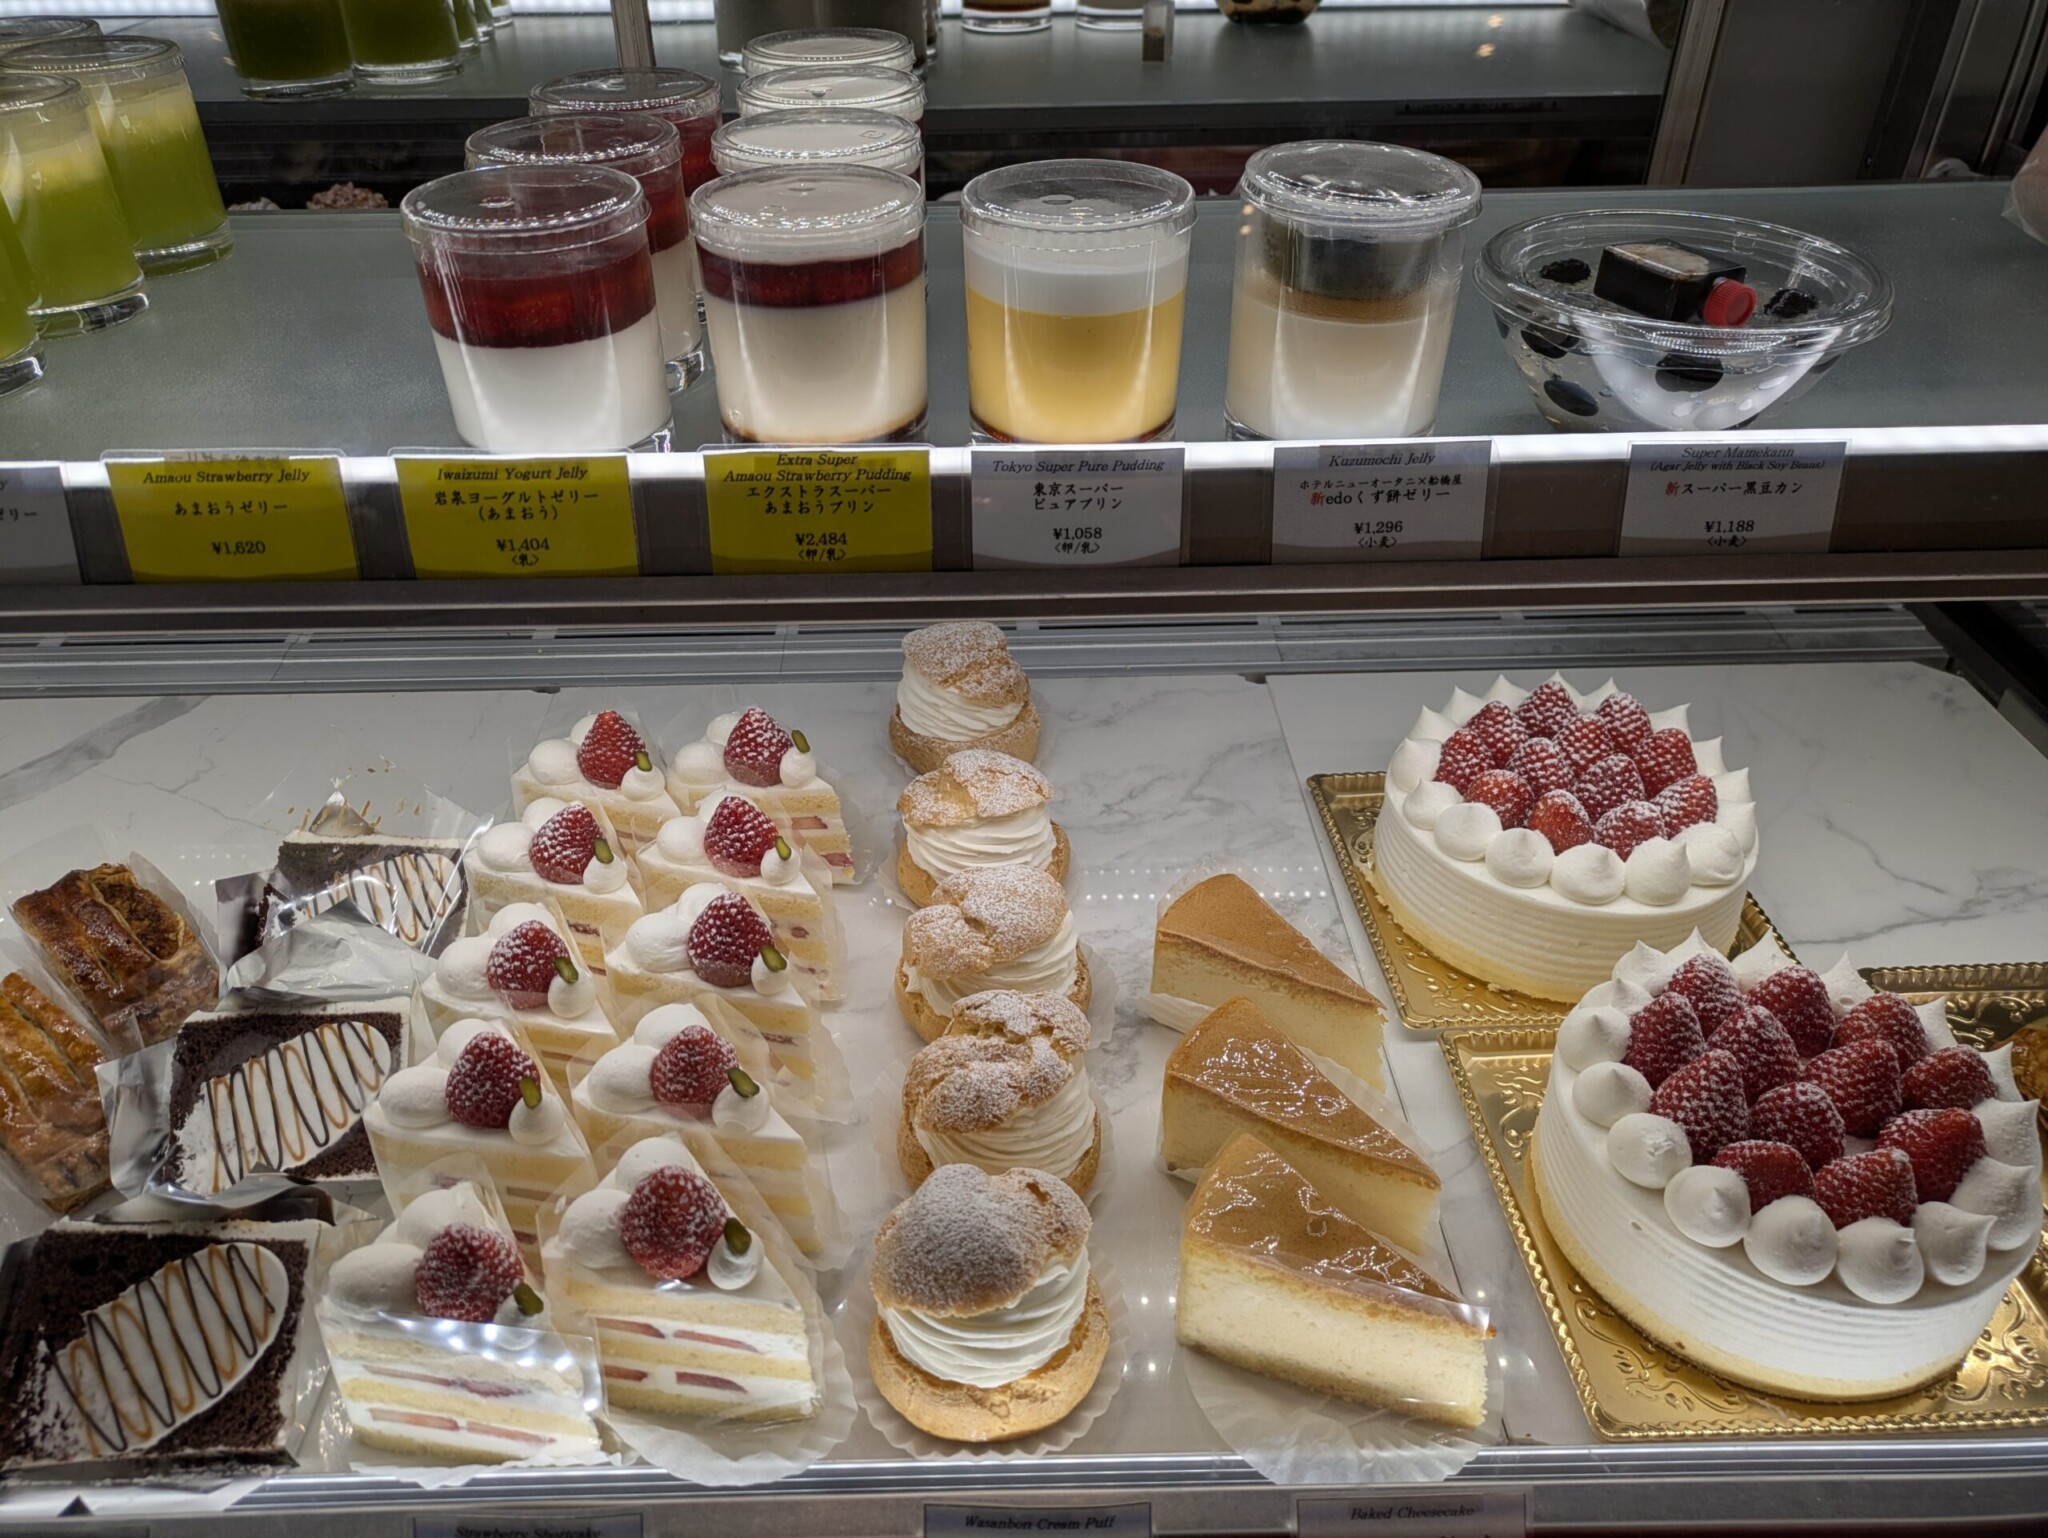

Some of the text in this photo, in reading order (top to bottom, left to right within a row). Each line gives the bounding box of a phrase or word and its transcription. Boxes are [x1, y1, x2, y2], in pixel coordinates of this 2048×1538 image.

[1329, 452, 1436, 467] Kuzumochi Jelly
[1681, 447, 1795, 459] Super Mamekann
[777, 454, 858, 467] Extra Super
[993, 459, 1165, 473] Tokyo Super Pure Pudding
[1651, 460, 1825, 472] (Agar Jelly with Black Soy Beans)
[143, 469, 310, 485] Amaou Strawberry Jelly
[437, 467, 587, 481] Iwaizumi Yogurt Jelly
[723, 468, 911, 483] Amaou Strawberry Pudding
[434, 491, 599, 506] 岩泉ヨーグルトゼリー
[174, 501, 288, 515] あまおうゼリー
[1053, 528, 1102, 540] ¥1,058
[1354, 521, 1403, 534] ¥1,296
[1705, 521, 1755, 533] ¥1,188
[497, 538, 550, 552] ¥1,404
[796, 533, 847, 546] ¥2,484
[212, 541, 266, 555] ¥1,620
[1351, 1505, 1475, 1520] Baked Cheesecake
[965, 1516, 1116, 1529] Wasanbon Cream Puff
[455, 1527, 601, 1538] Strawberry Shortcake
